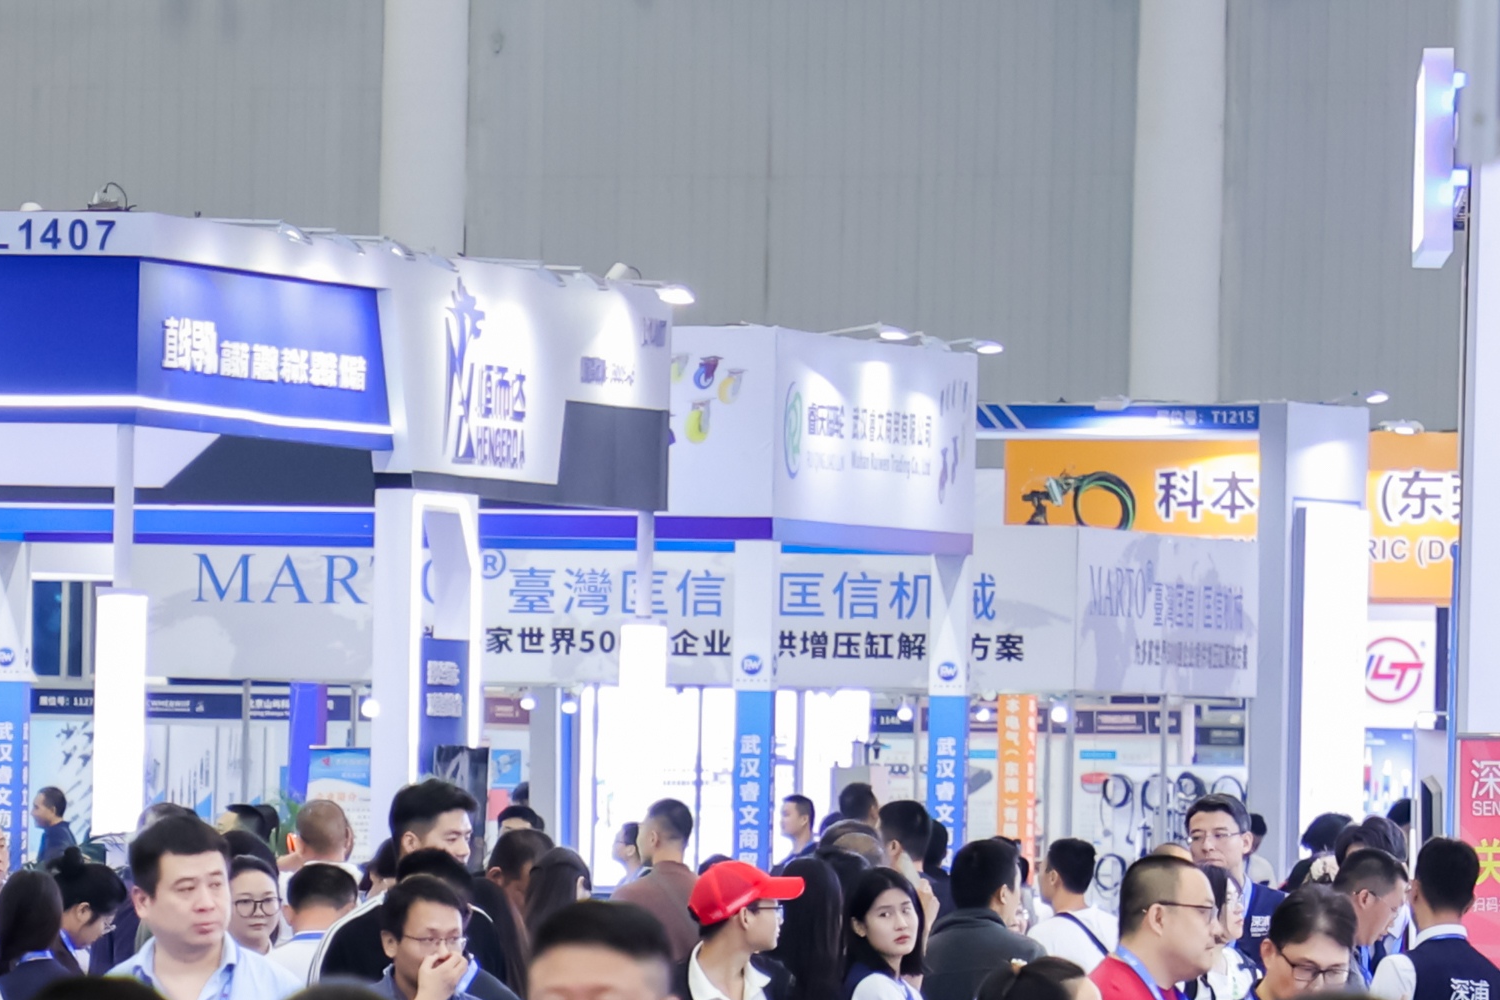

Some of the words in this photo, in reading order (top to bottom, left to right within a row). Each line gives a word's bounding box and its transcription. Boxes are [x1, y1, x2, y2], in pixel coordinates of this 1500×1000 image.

[1211, 410, 1256, 425] T1215
[1156, 469, 1256, 521] 科本
[193, 552, 435, 605] MAR
[935, 736, 957, 866] 武汉睿文
[1470, 758, 1500, 800] 深
[1472, 896, 1500, 913] 扫码
